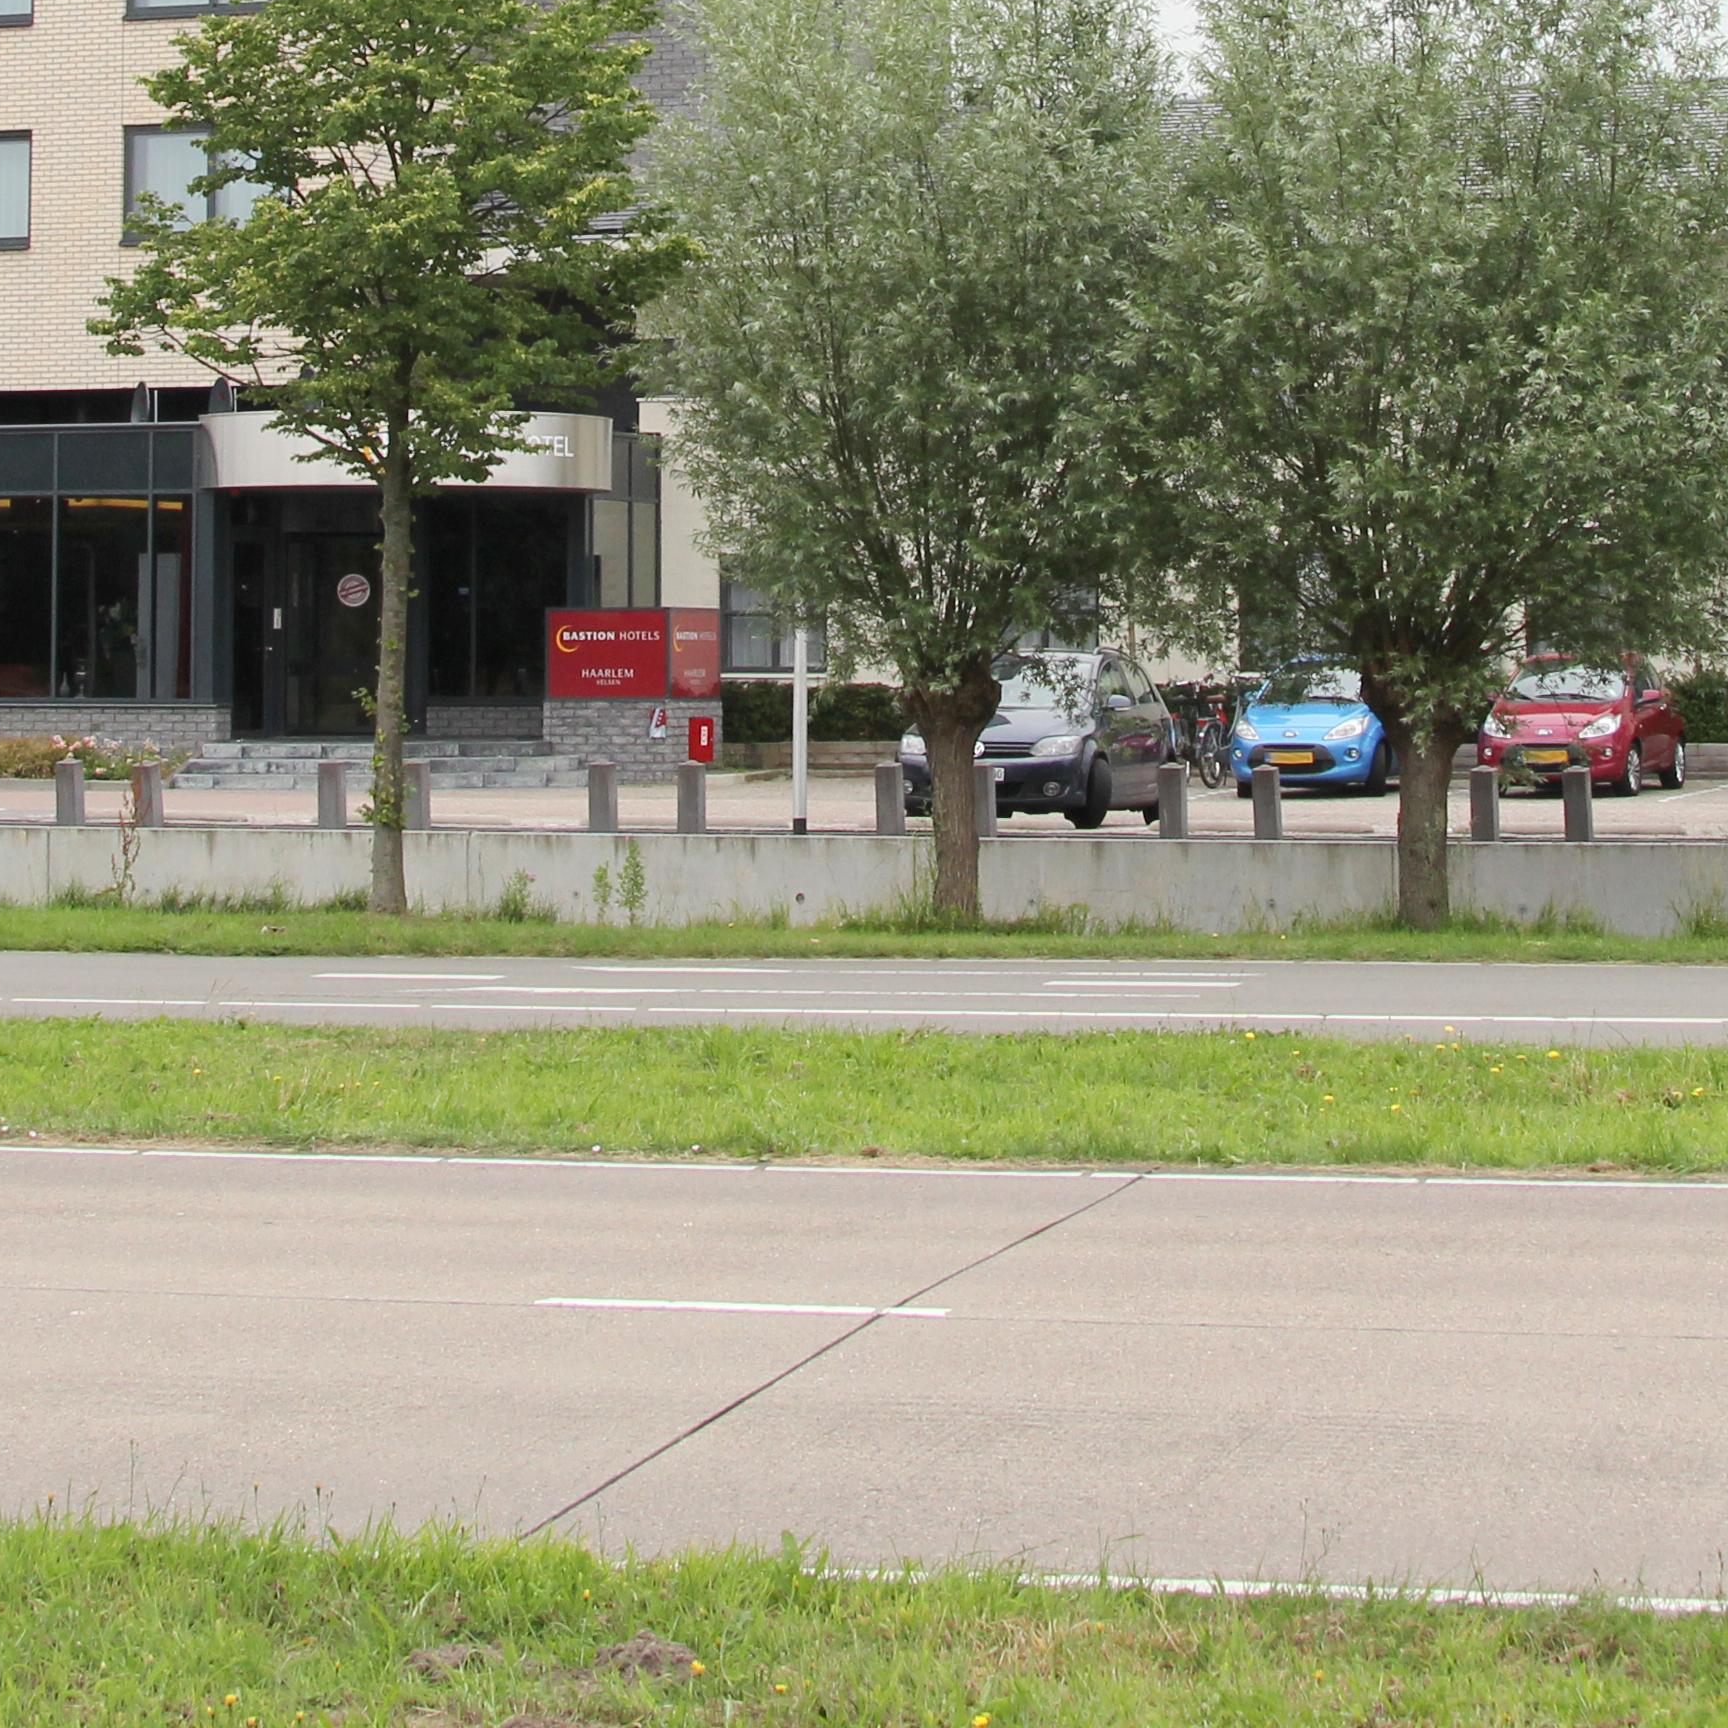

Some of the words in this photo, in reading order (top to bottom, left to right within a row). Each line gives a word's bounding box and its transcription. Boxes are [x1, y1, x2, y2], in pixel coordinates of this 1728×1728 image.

[562, 630, 615, 641] BASTION
[619, 630, 661, 641] HOTELS
[581, 668, 634, 679] HAARLEM
